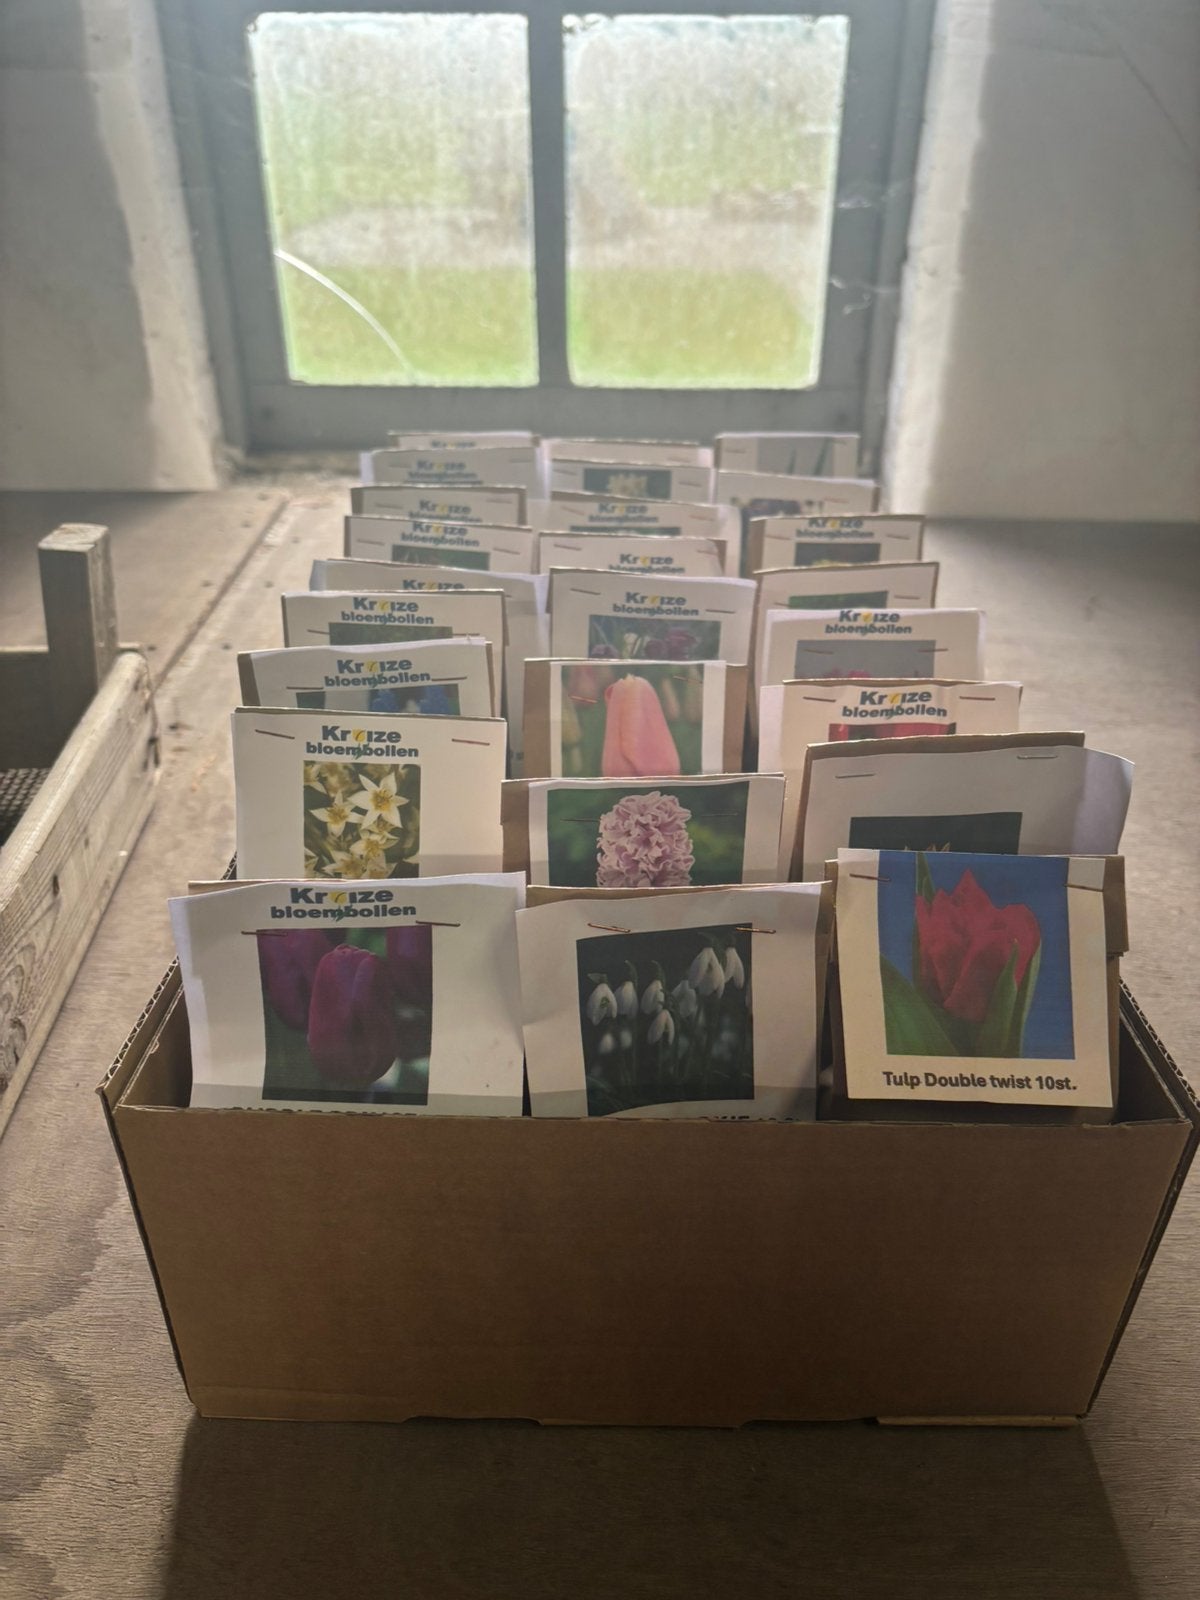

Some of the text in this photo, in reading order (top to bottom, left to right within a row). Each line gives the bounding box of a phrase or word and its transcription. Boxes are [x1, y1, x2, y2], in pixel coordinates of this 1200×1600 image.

[341, 611, 434, 624] bloembollen
[825, 624, 912, 635] bloembollen
[324, 672, 431, 687] bloembollen
[842, 704, 947, 718] bloembollen
[306, 742, 419, 758] bloembollen
[270, 904, 417, 920] bloembollen
[882, 1071, 1078, 1090] Tulp Double twist 10st.
